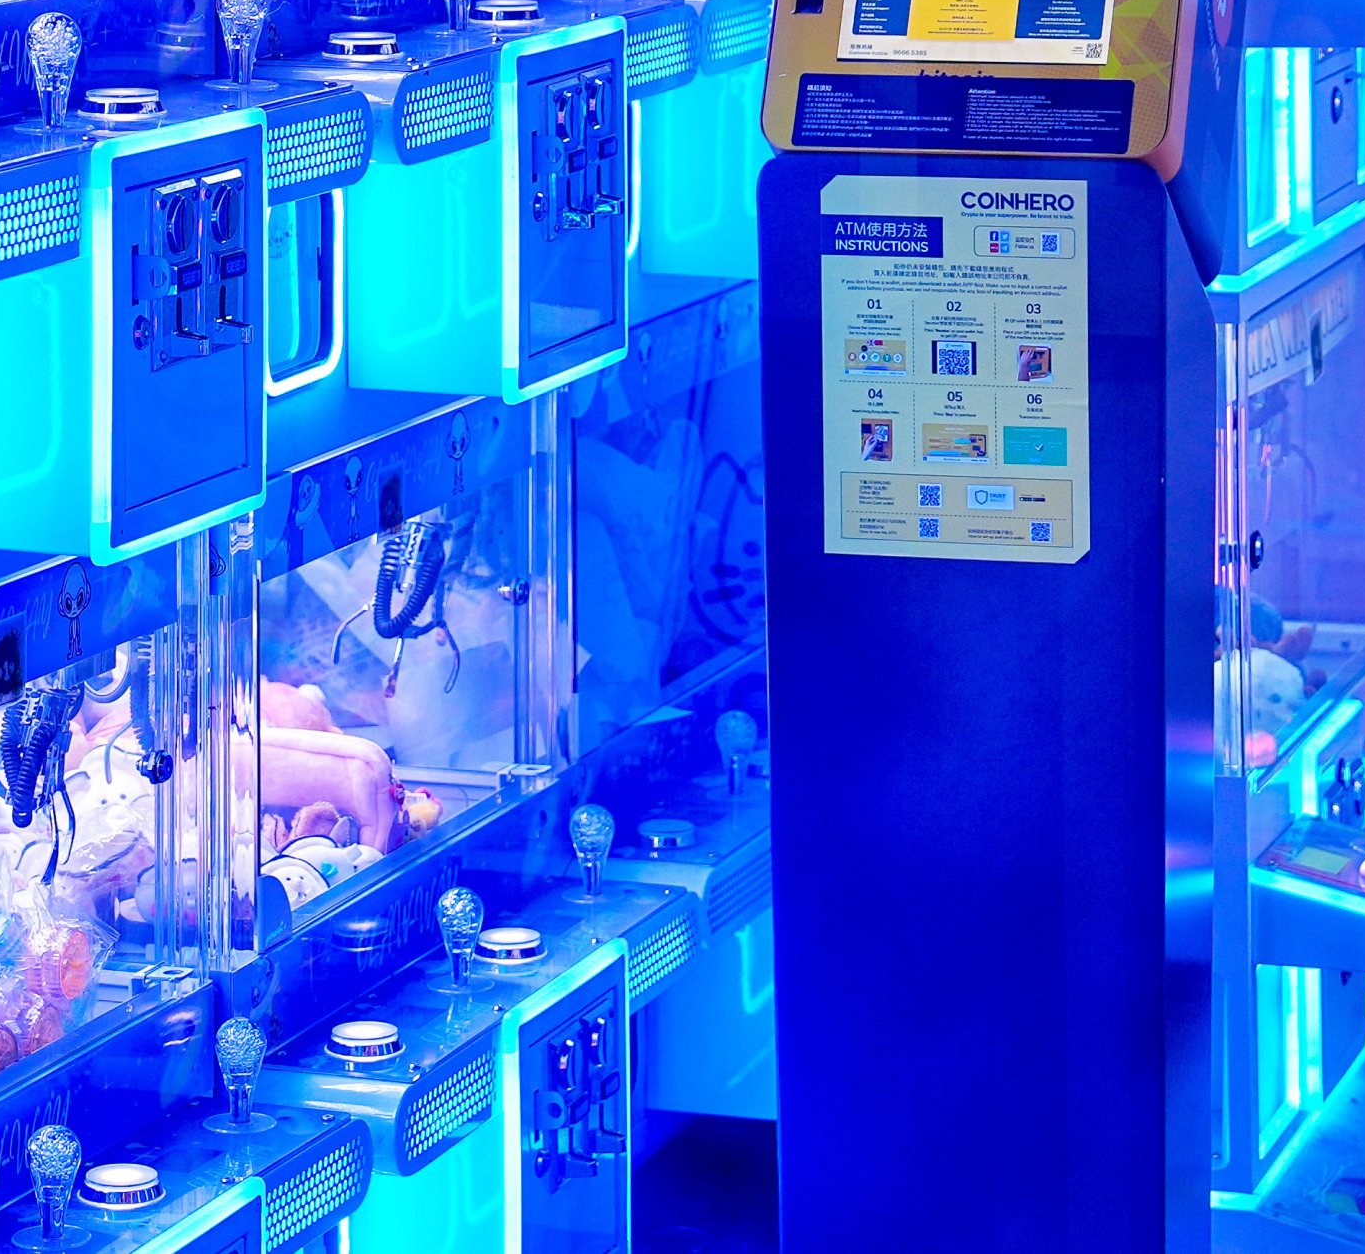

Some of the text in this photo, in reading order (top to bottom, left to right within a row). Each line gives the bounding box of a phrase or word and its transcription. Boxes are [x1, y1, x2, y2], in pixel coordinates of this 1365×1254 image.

[960, 191, 1075, 212] COINHERO
[835, 221, 928, 238] ATM使用方法
[835, 239, 929, 253] INSTRUCTIONS
[867, 298, 882, 309] 01
[946, 301, 962, 312] 02
[1026, 303, 1042, 314] 03
[868, 388, 883, 399] 04
[947, 391, 963, 402] 05
[1026, 394, 1043, 404] 06
